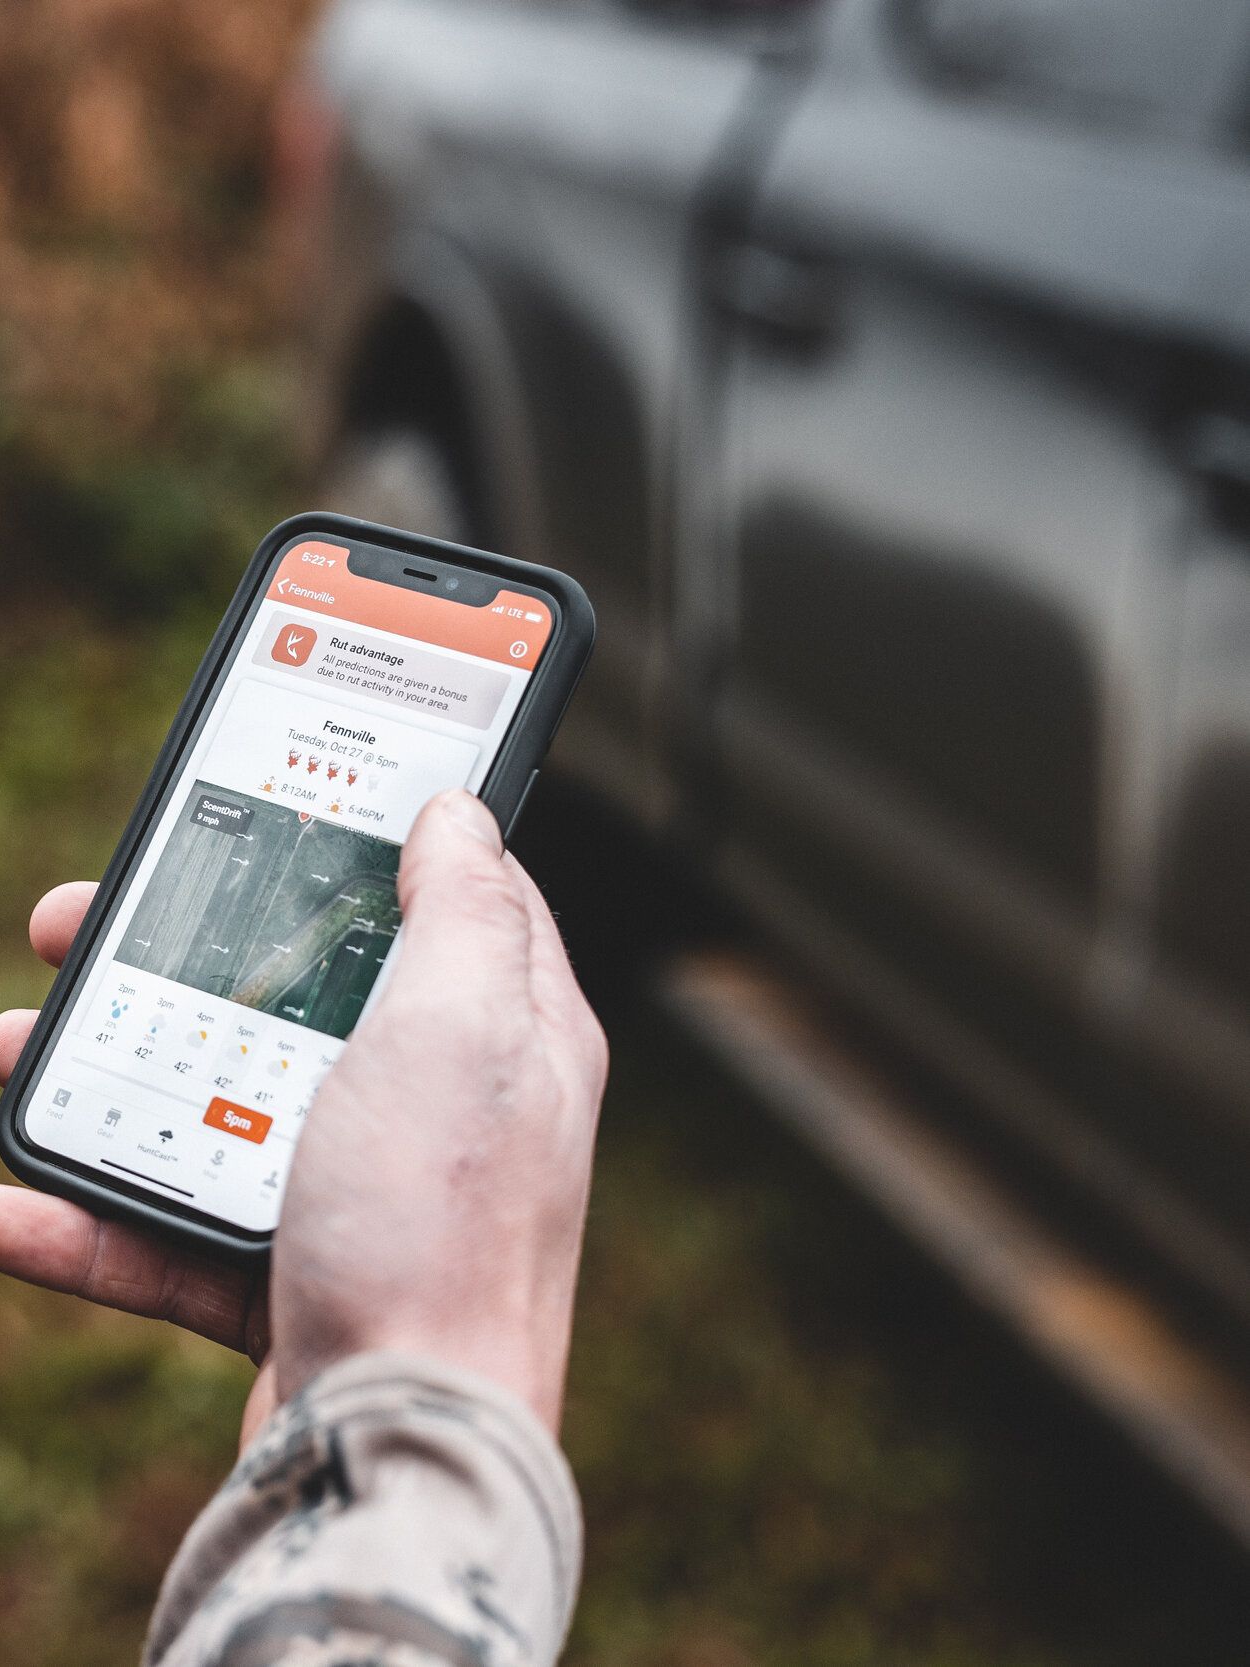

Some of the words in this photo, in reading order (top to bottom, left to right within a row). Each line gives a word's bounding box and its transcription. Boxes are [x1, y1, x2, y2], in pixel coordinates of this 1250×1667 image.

[301, 551, 326, 567] 5:22
[288, 583, 335, 604] Fennville
[507, 606, 523, 619] LTE
[329, 637, 349, 651] Rut
[349, 644, 404, 667] advantage
[317, 666, 334, 678] due
[336, 671, 345, 681] to
[347, 675, 360, 686] rut
[361, 679, 394, 697] activity
[395, 688, 404, 698] in
[404, 692, 427, 705] your
[427, 699, 449, 712] area.
[322, 654, 335, 664] All
[335, 657, 386, 679] predictions
[387, 673, 403, 684] are
[404, 678, 429, 691] given
[430, 685, 437, 694] a
[439, 686, 468, 702] bonus
[322, 720, 376, 745] Fennville
[288, 728, 328, 751] Tuesday,
[330, 741, 348, 755] Oct
[349, 747, 363, 758] 27
[363, 752, 375, 764] @
[376, 755, 399, 770] 5pm
[280, 784, 317, 801] 8:12AM
[348, 805, 385, 822] 6:46PM
[197, 812, 203, 820] 9
[203, 816, 220, 826] mph
[118, 983, 136, 996] 2pm
[157, 997, 175, 1010] 3pm
[196, 1011, 215, 1025] 4pm
[237, 1025, 255, 1038] 5pm
[95, 1032, 114, 1044] 41°
[134, 1046, 153, 1060] 42°
[173, 1060, 192, 1075] 42°
[214, 1075, 233, 1089] 42°
[254, 1091, 273, 1103] 41°
[223, 1109, 252, 1131] 5pm
